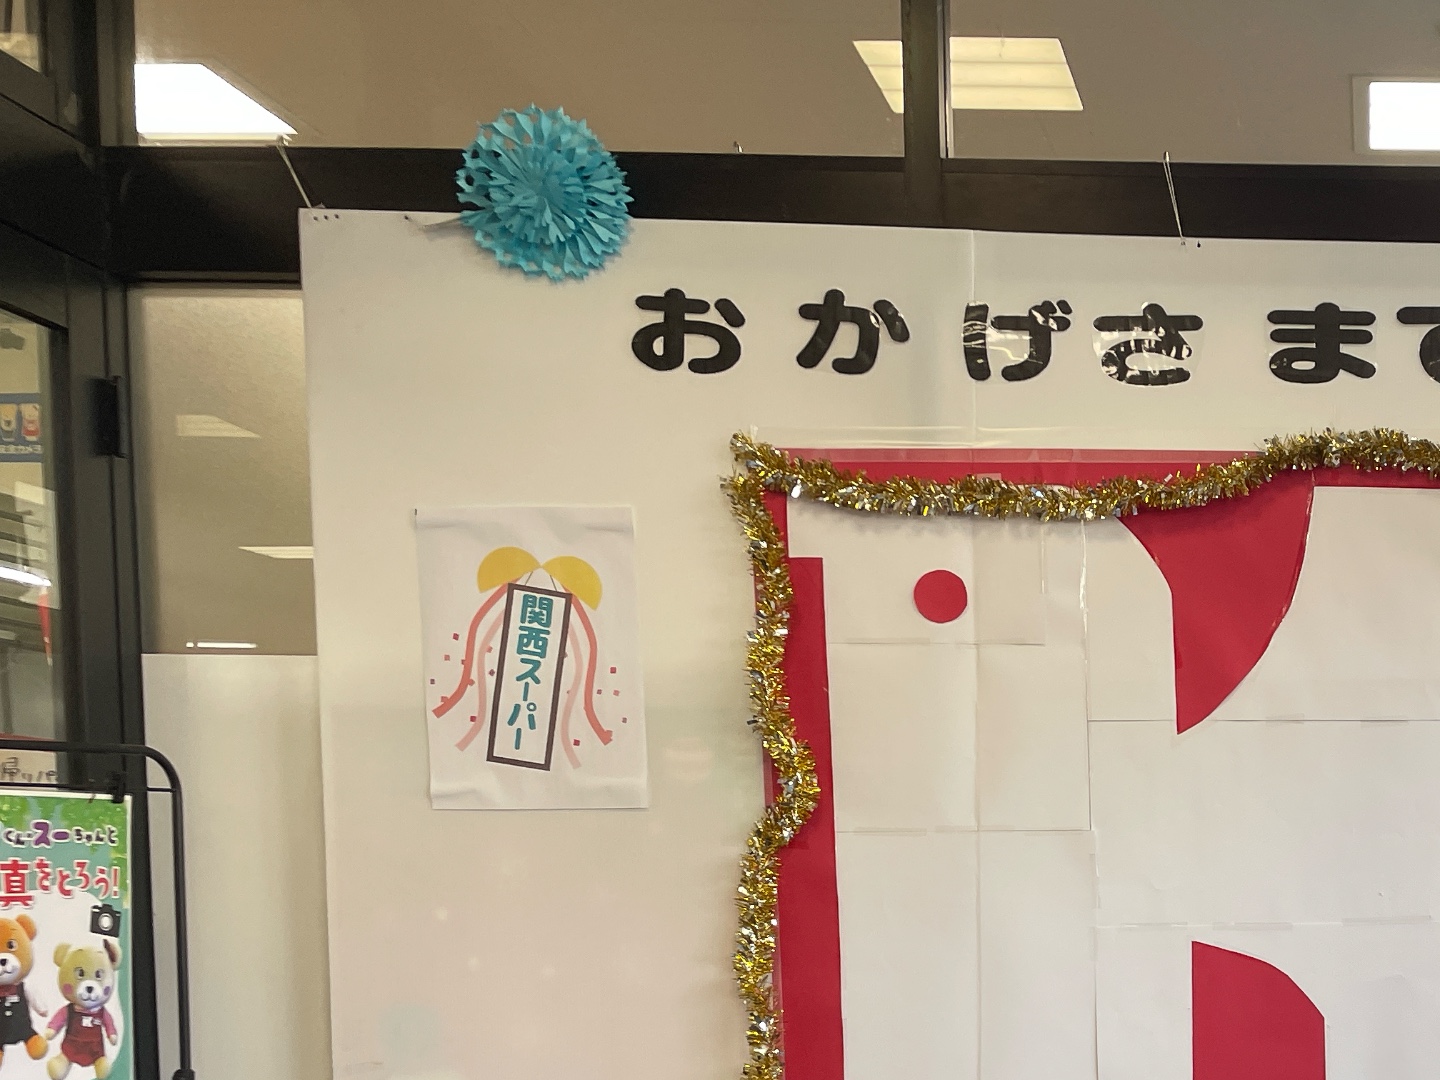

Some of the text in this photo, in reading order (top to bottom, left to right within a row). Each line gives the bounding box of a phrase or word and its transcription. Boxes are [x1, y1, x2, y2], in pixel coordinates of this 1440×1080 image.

[507, 593, 554, 751] 関西スーパー
